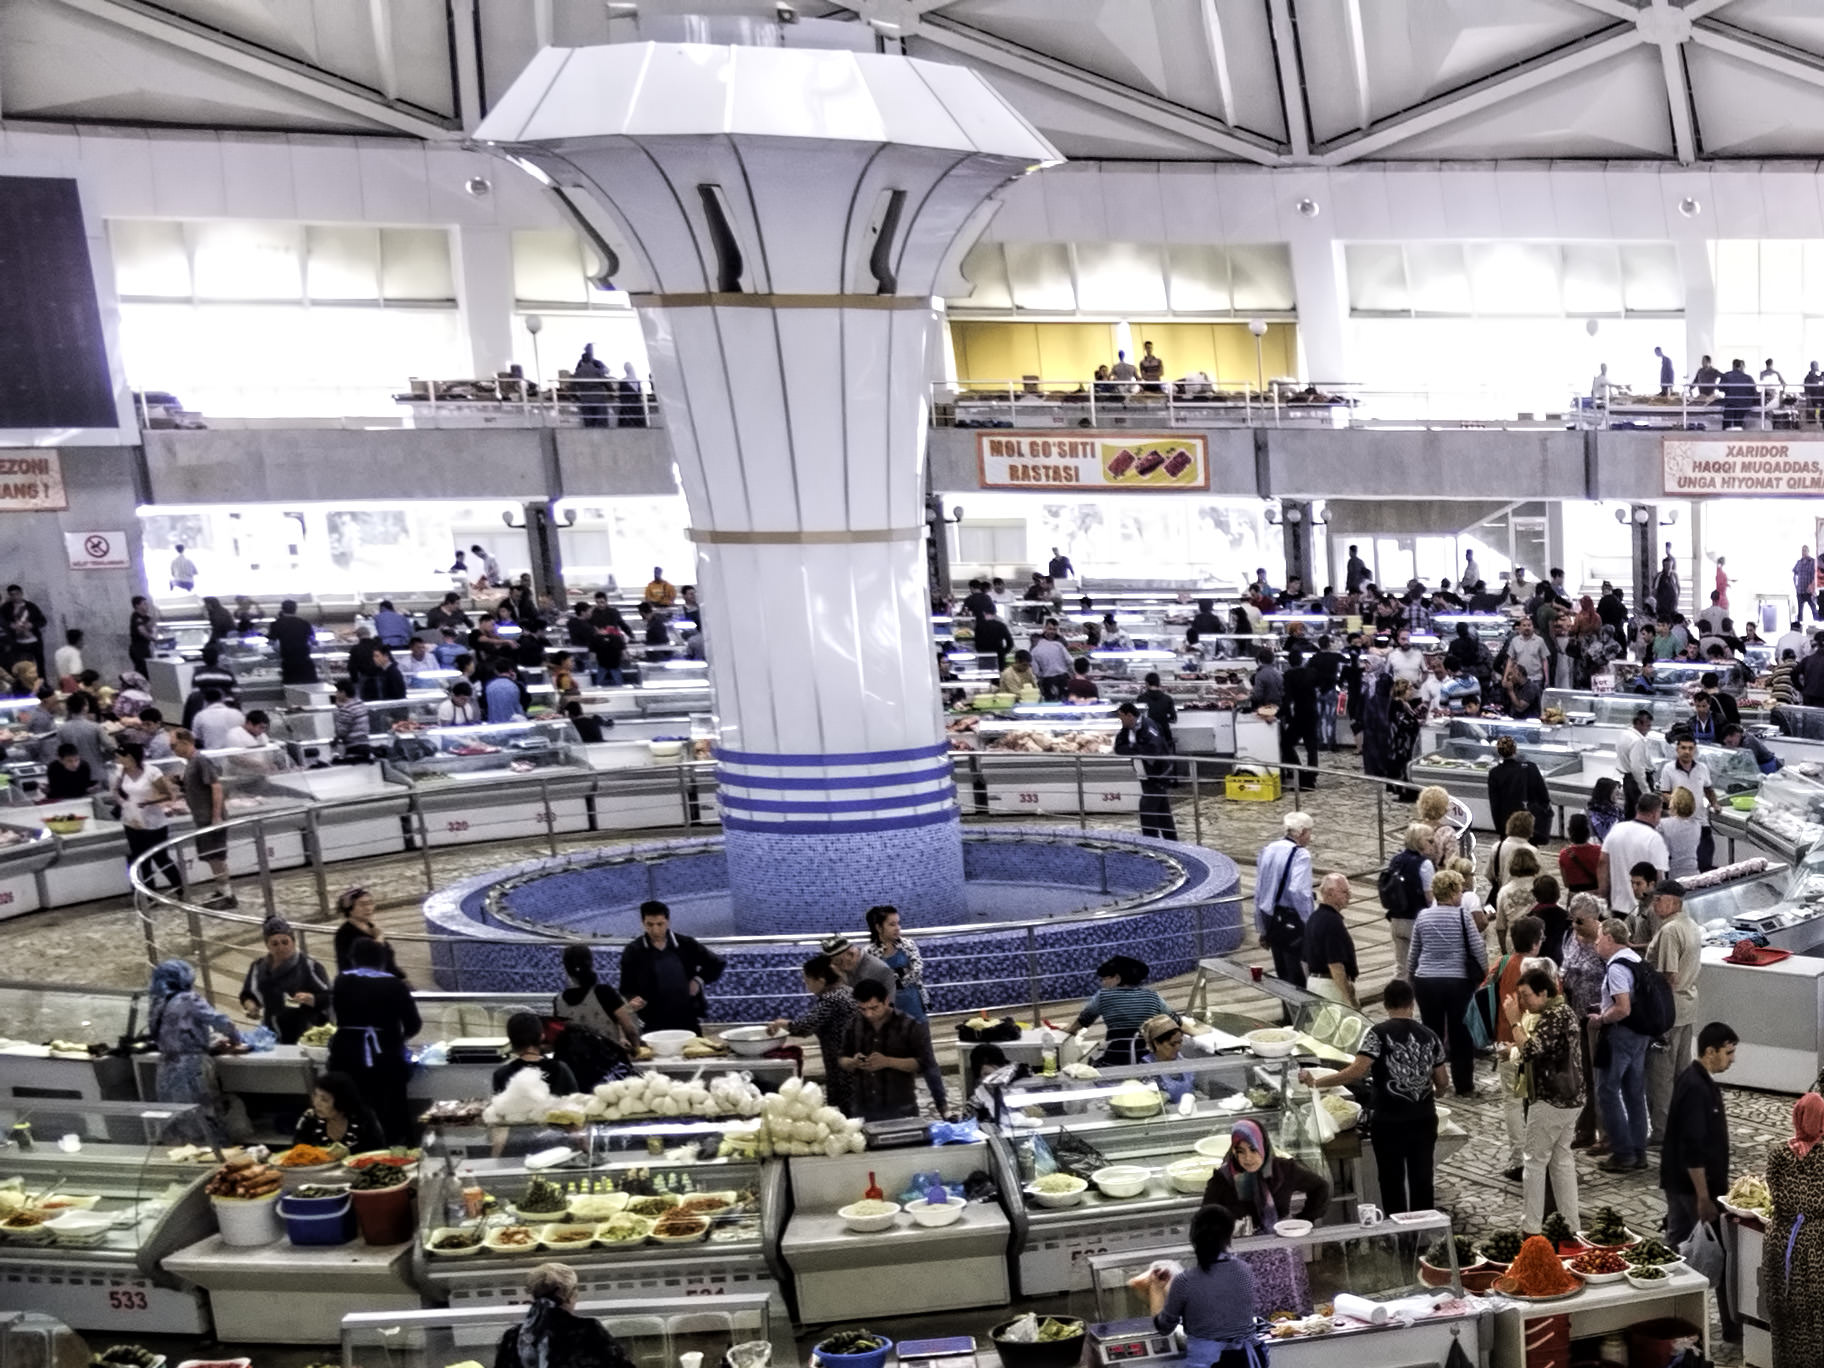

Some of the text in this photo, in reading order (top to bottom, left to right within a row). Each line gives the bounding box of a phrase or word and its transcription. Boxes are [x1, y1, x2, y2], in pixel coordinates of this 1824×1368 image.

[989, 440, 1024, 458] MOL
[1725, 445, 1789, 458] XARIDOR
[1009, 464, 1080, 483] RASTASI
[1692, 461, 1823, 475] HAQQI MUQADDAS,
[1677, 476, 1717, 489] UNGA
[1720, 477, 1783, 489] HIYONAT
[1019, 793, 1039, 803] 333
[109, 1291, 147, 1310] 533
